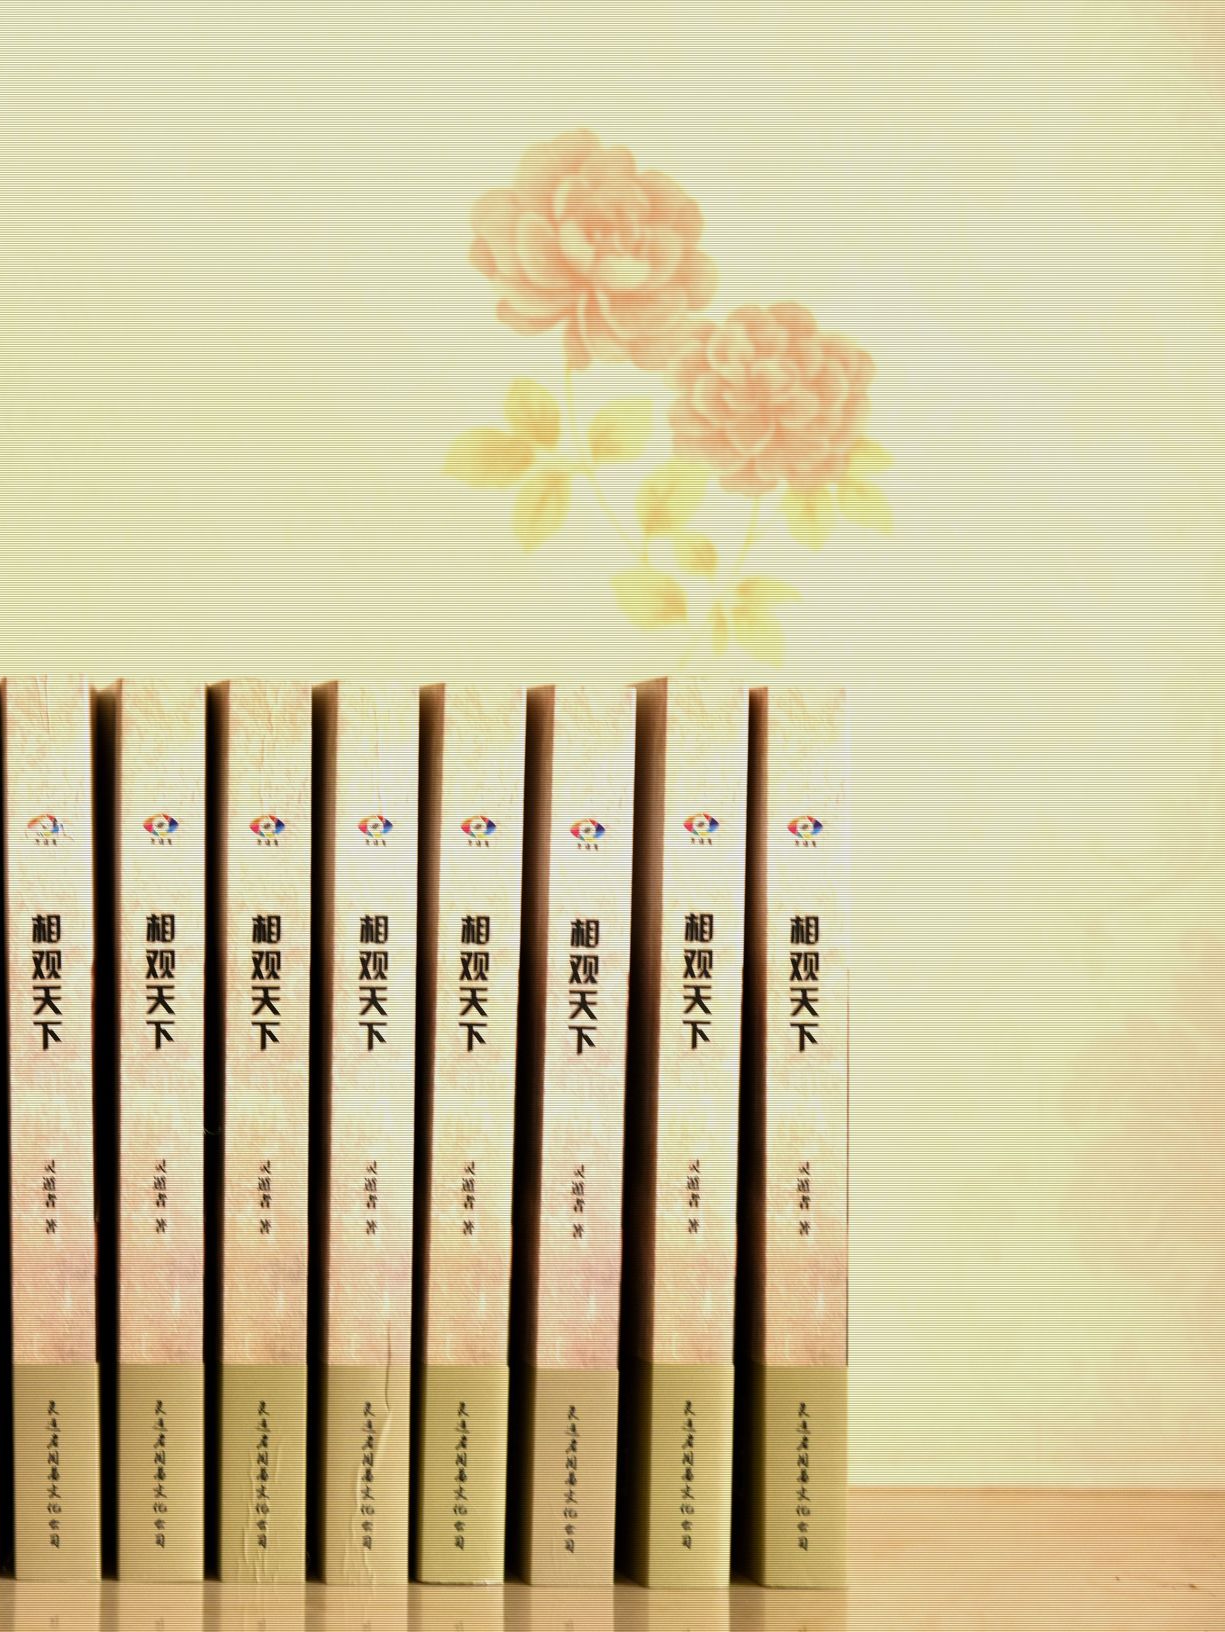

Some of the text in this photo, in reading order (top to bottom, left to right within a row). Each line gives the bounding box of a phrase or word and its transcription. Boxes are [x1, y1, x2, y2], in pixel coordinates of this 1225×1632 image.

[32, 914, 64, 1054] 相观天下
[146, 913, 177, 1053] 相观天下
[251, 914, 283, 1054] 相观天下
[359, 915, 390, 1054] 相观天下
[459, 915, 492, 1055] 相观天下
[568, 919, 601, 1058] 相观天下
[683, 913, 715, 1053] 相观天下
[790, 916, 821, 1056] 相观天下
